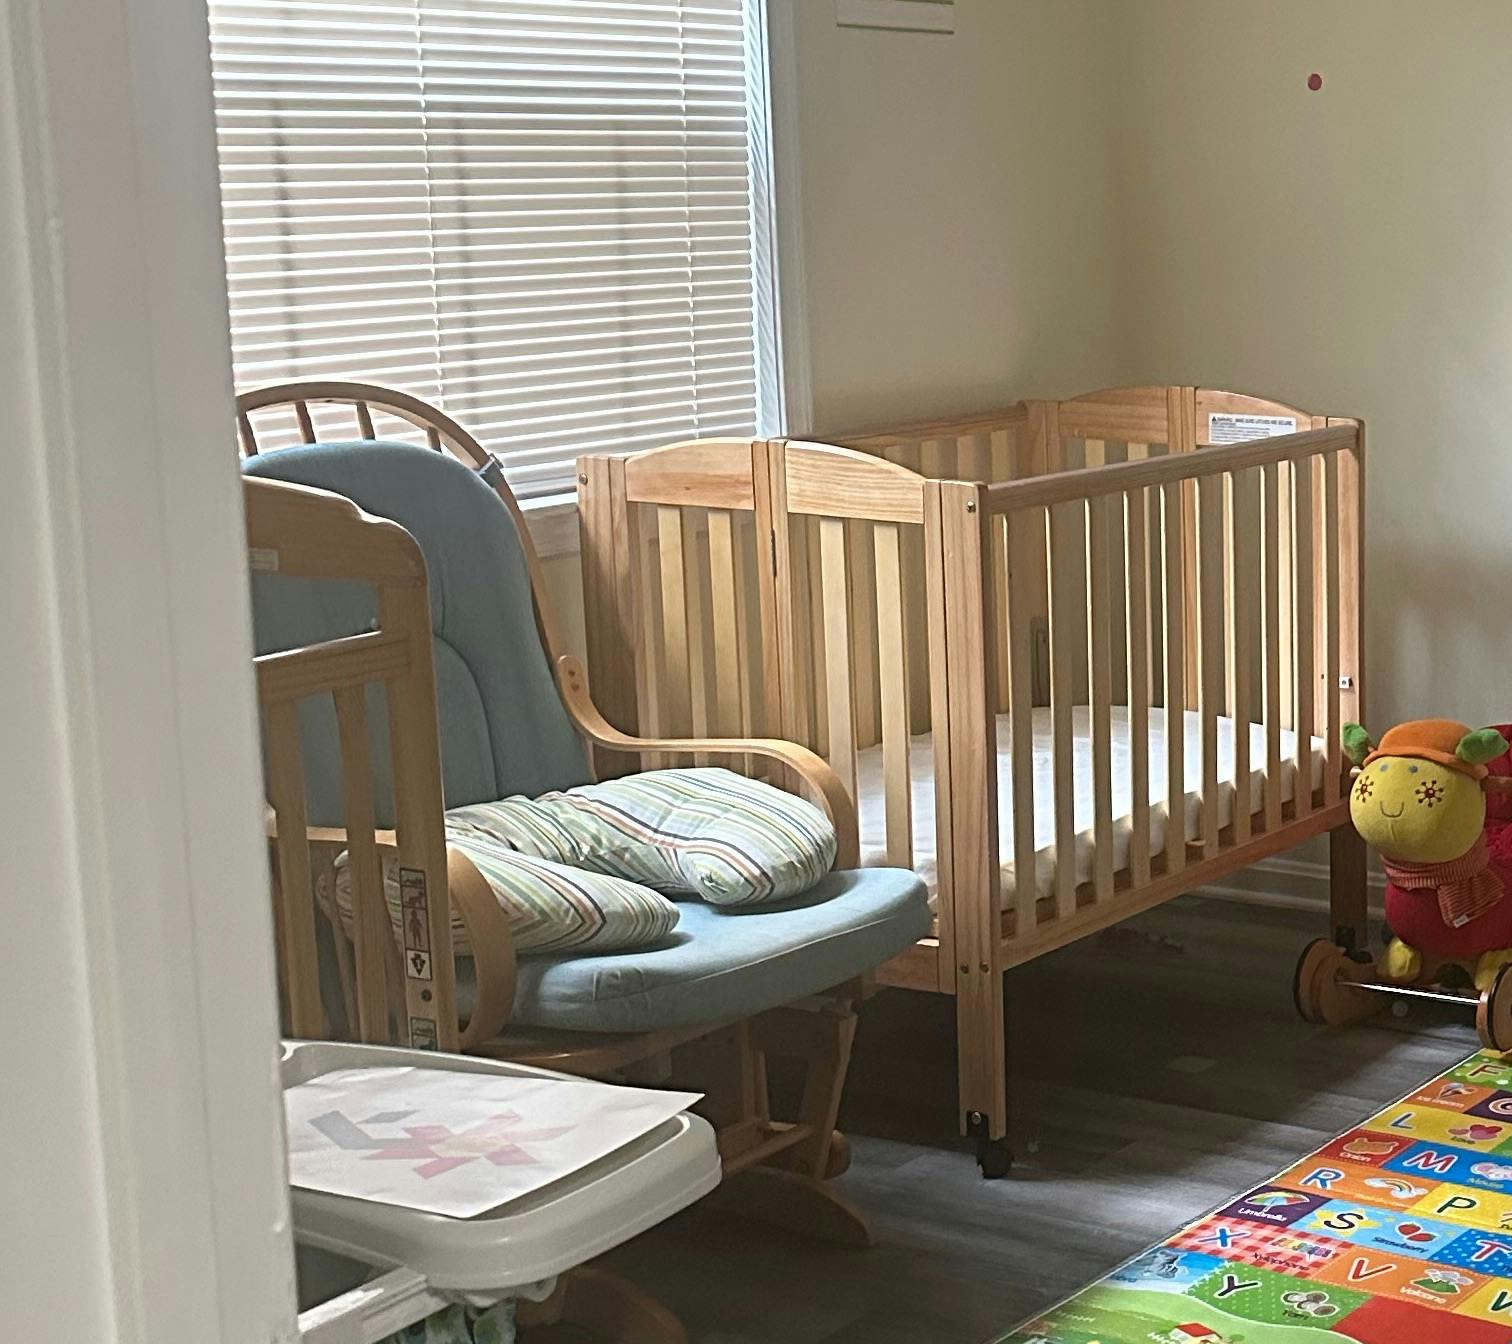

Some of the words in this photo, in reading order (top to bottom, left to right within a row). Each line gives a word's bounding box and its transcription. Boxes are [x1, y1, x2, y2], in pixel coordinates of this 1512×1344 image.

[1468, 1062, 1509, 1080] F
[1390, 1111, 1416, 1130] L
[1402, 1150, 1459, 1174] M
[1300, 1167, 1346, 1191] R
[1435, 1196, 1479, 1215] P
[1322, 1211, 1365, 1231] S
[1197, 1225, 1253, 1248] X
[1347, 1256, 1398, 1283] V
[1213, 1273, 1263, 1301] Y
